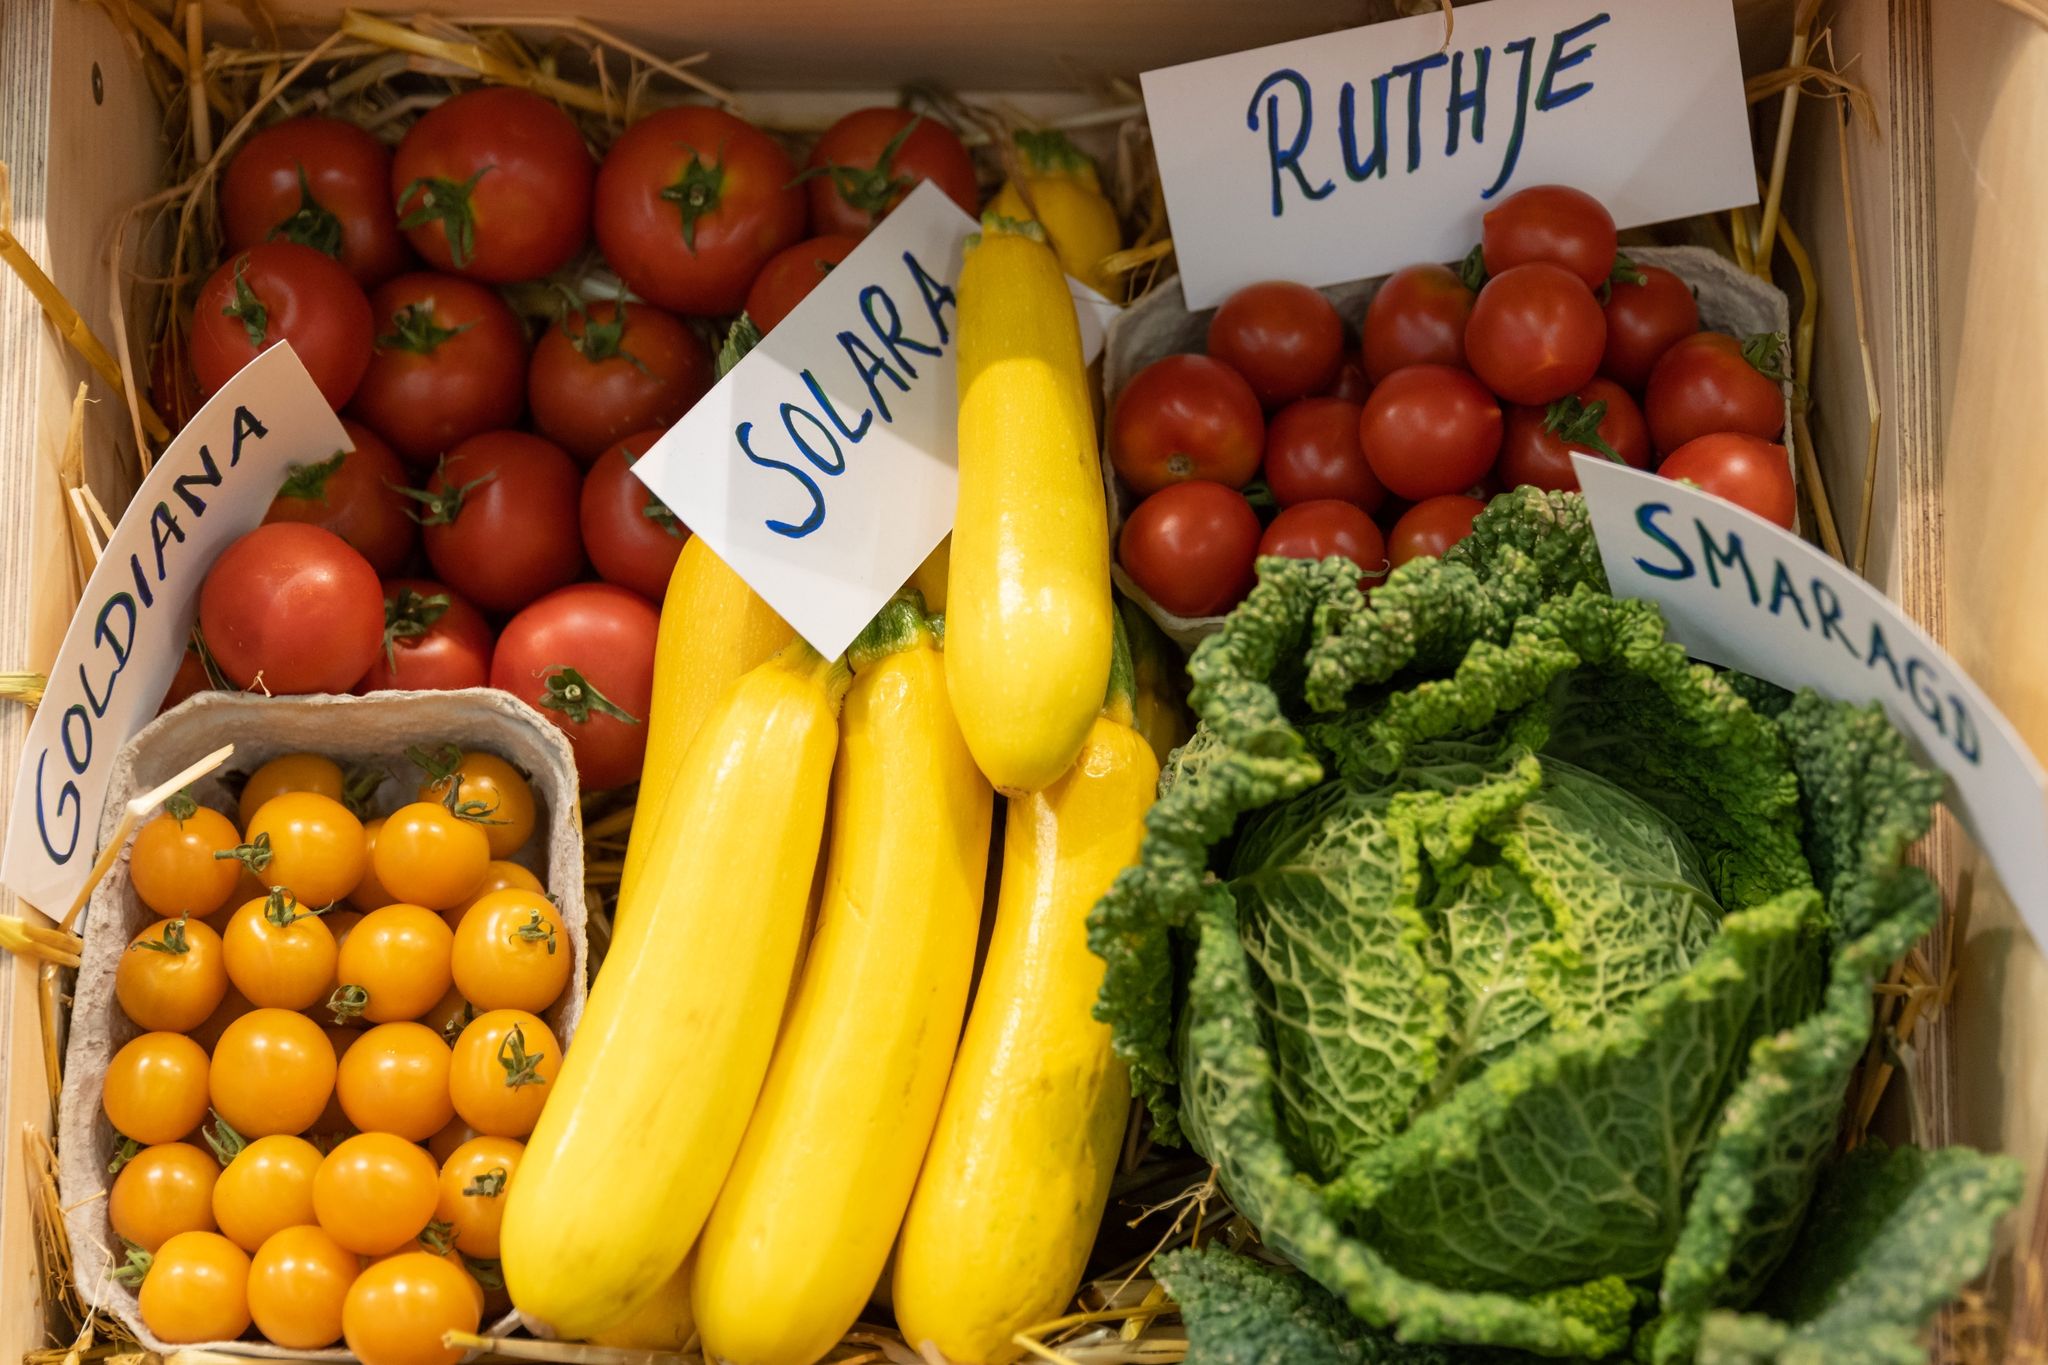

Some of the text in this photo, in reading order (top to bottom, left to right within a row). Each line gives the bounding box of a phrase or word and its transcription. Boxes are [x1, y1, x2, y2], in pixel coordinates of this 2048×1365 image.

[1247, 13, 1611, 217] RUTHJE
[735, 251, 958, 539] SOLARA
[36, 405, 269, 865] GOLDIANA
[1632, 502, 1982, 766] SMARAGD
